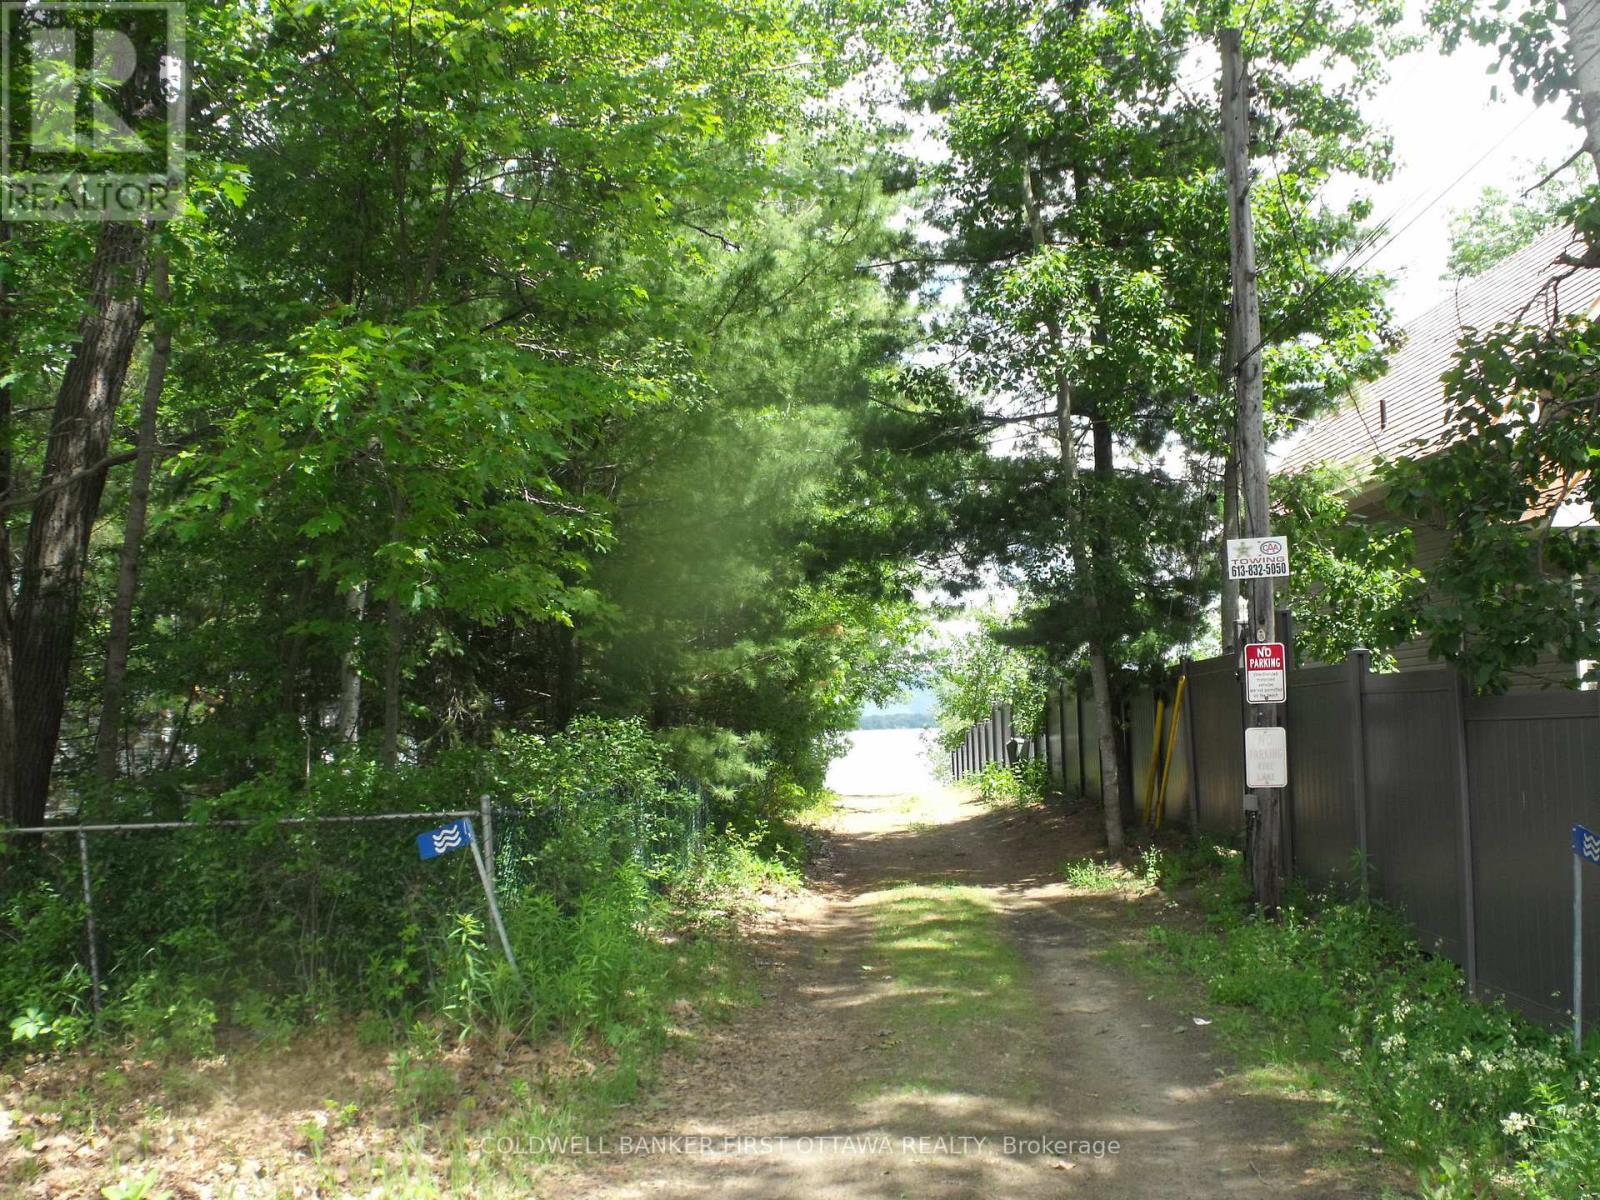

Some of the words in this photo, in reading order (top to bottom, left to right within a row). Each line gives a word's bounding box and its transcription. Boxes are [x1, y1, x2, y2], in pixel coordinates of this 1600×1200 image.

[1262, 543, 1279, 553] CAA
[1232, 556, 1285, 565] TOWING
[1231, 563, 1287, 577] 613-832-5050
[1257, 648, 1272, 658] NO
[1249, 658, 1281, 668] PARKING
